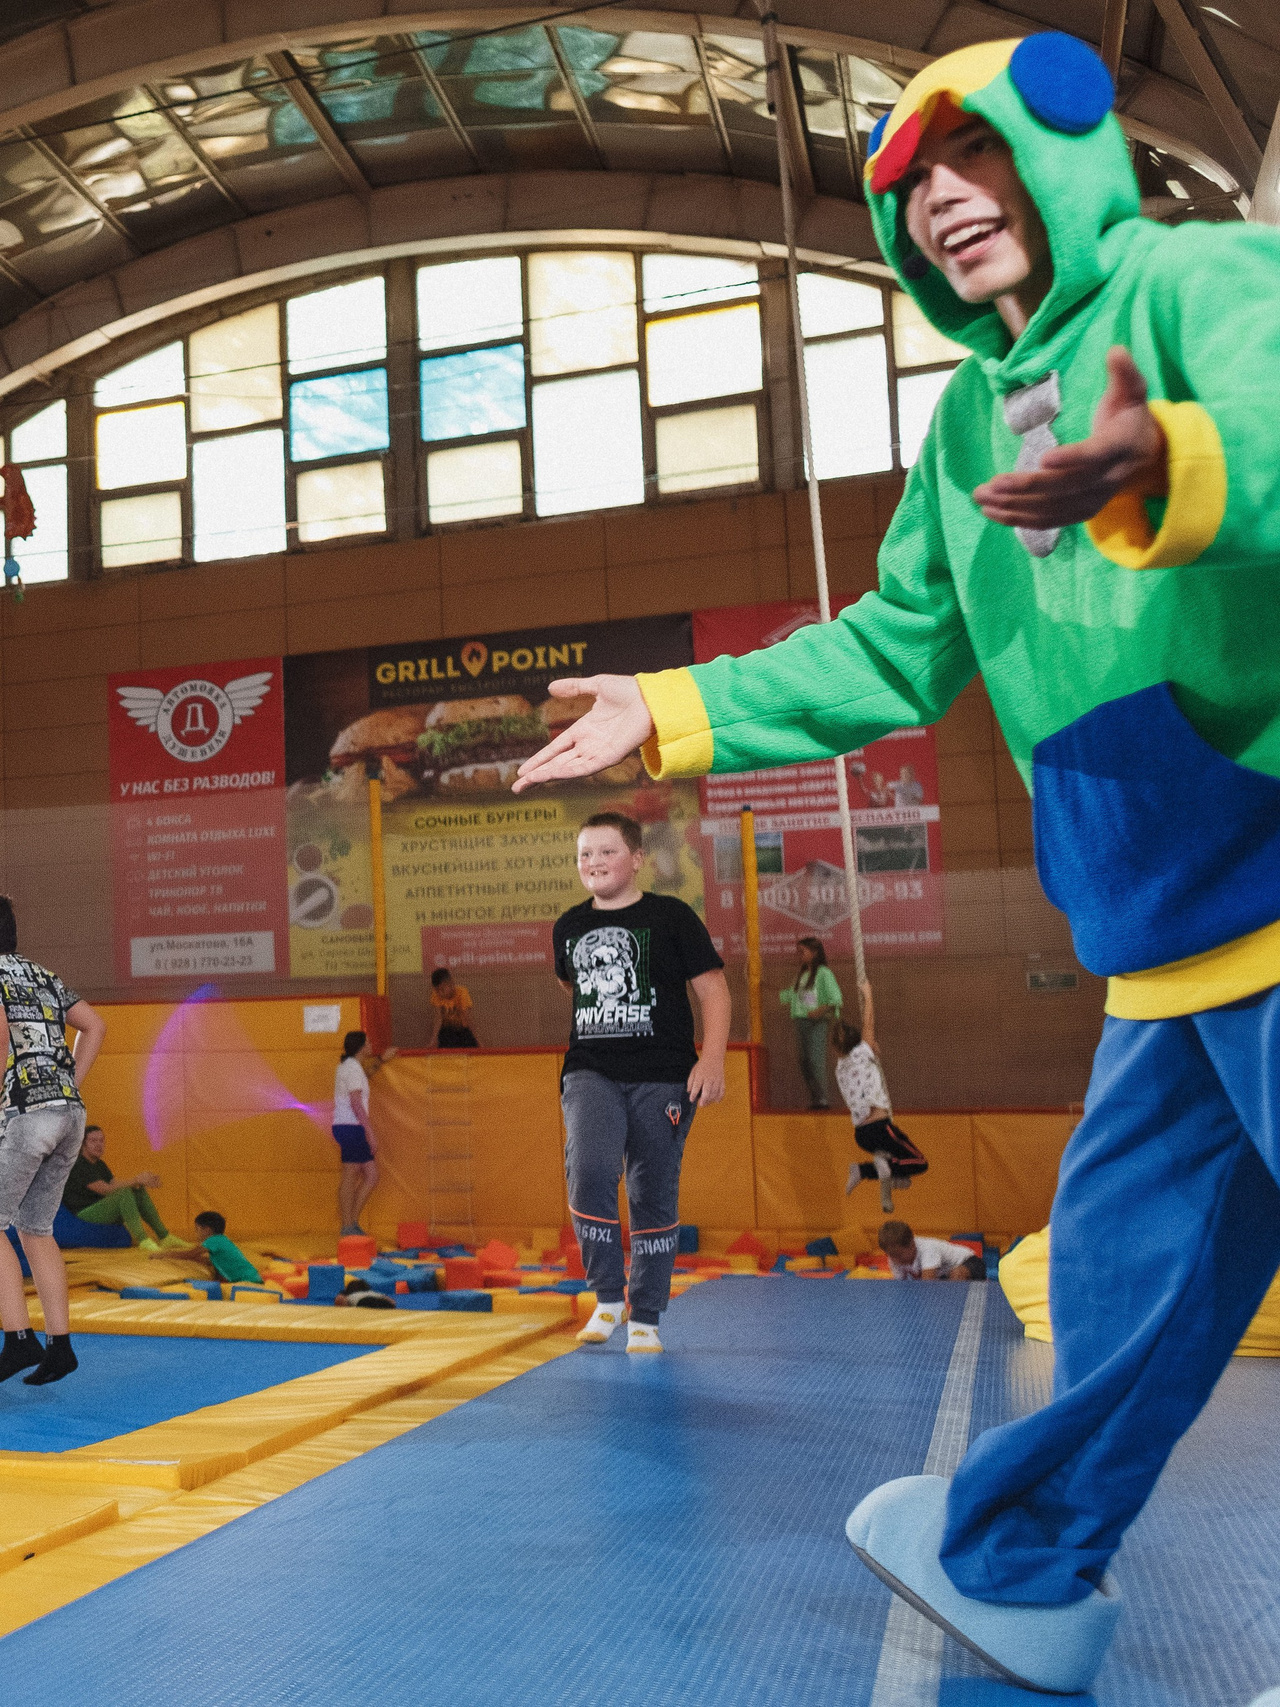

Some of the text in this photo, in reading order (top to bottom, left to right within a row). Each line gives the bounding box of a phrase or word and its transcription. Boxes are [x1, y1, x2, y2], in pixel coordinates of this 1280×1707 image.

[376, 641, 588, 684] GRILL POINT
[180, 703, 210, 737] Д
[120, 770, 276, 797] У НАС БЕЗ РАЗВОДОВ!
[414, 808, 557, 830] СОЧНЫЕ БУРГЕРЫ
[400, 836, 494, 853] ХРУСТЯЩИЕ
[391, 858, 497, 877] ВКУСНЕЙШИЕ
[405, 879, 573, 899] АППЕТИТНЫЕ РОЛЛЫ
[430, 906, 496, 923] МНОГОЕ
[501, 901, 561, 919] ДРУГОЕ
